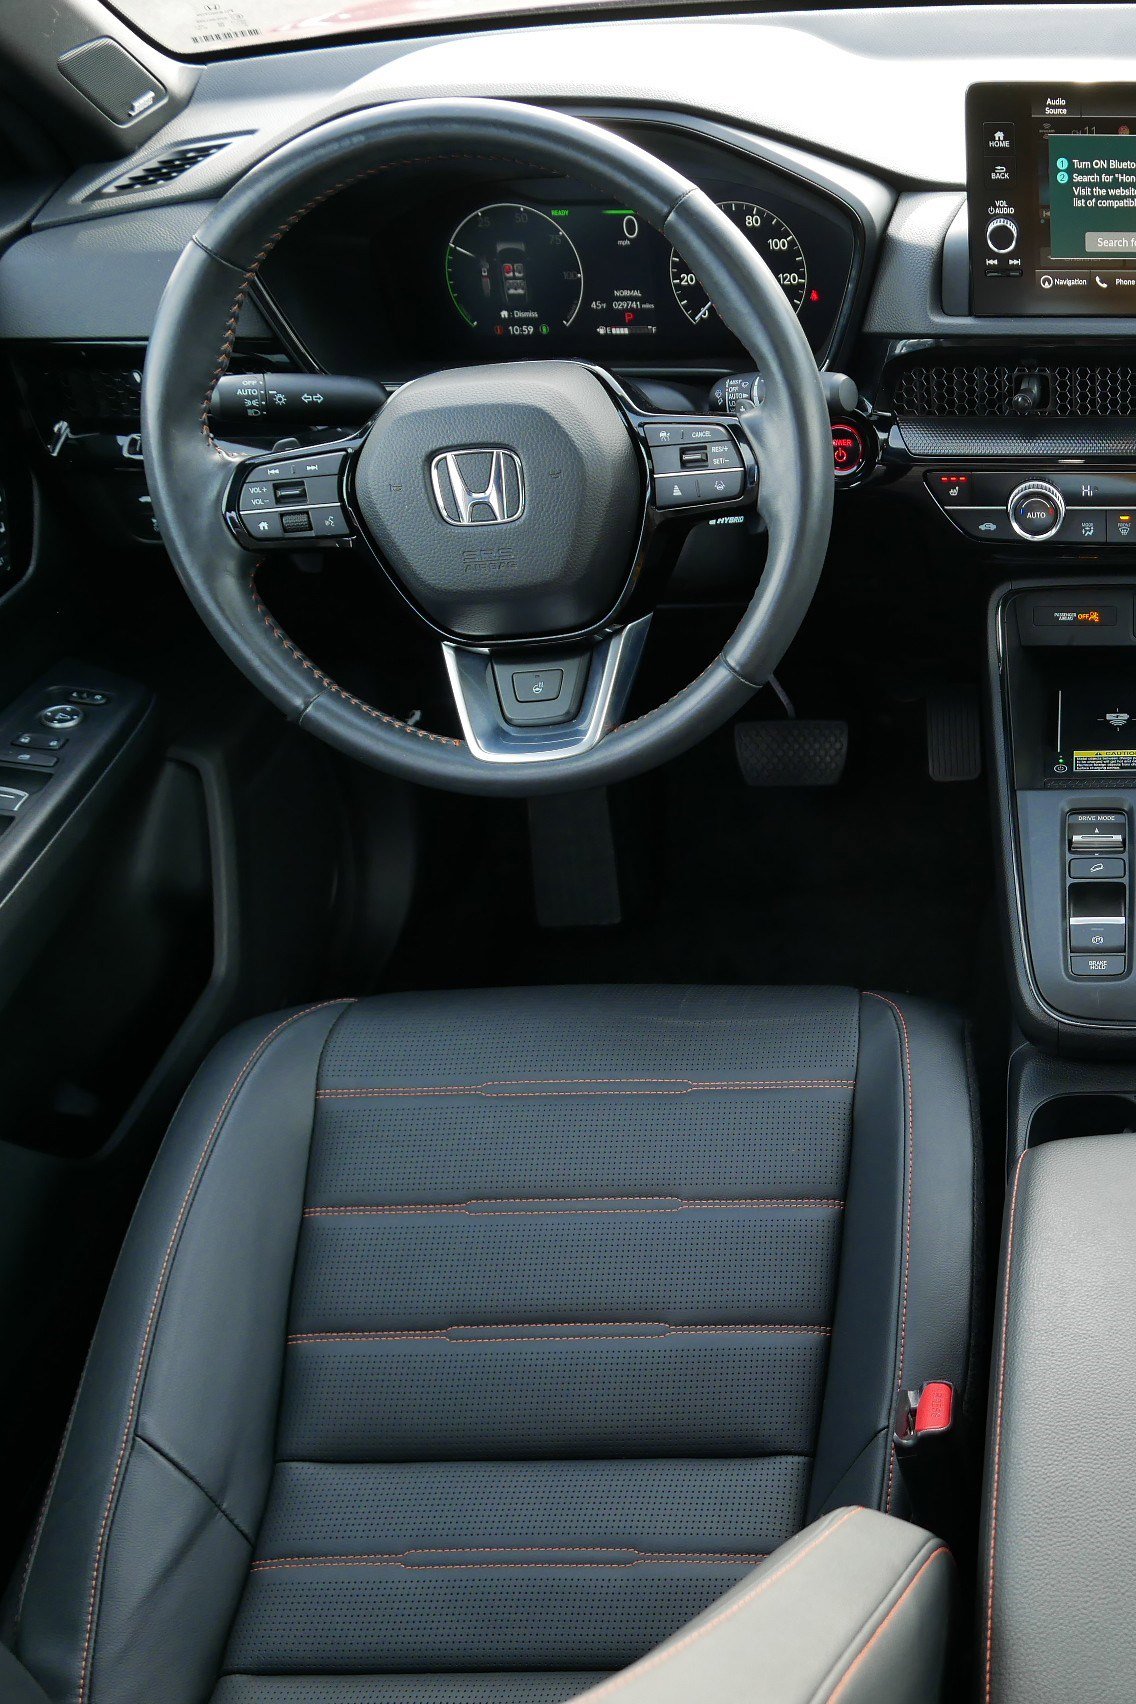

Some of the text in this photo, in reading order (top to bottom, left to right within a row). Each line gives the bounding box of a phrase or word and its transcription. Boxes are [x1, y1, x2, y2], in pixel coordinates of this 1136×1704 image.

[1045, 107, 1067, 115] Source
[1072, 159, 1091, 169] Turn
[1092, 159, 1107, 169] ON
[1072, 173, 1100, 182] Search
[1101, 173, 1113, 182] for
[1072, 186, 1091, 196] Visit
[1093, 186, 1107, 196] the
[1073, 198, 1085, 207] list
[1086, 198, 1096, 207] of
[745, 215, 761, 227] 80
[623, 215, 638, 238] 0
[767, 239, 788, 250] 100
[1097, 237, 1129, 247] Search
[680, 274, 696, 285] 20
[778, 273, 798, 285] 120
[1054, 278, 1087, 287] Navigation
[1115, 278, 1136, 286] Phone
[614, 289, 642, 297] NORMAL
[612, 301, 641, 309] 029741
[513, 310, 538, 318] Dismiss
[625, 312, 634, 323] P
[508, 325, 534, 335] 10:59
[691, 430, 712, 438] CANCEL
[1026, 511, 1046, 519] AUTO
[716, 516, 744, 524] HYBRID
